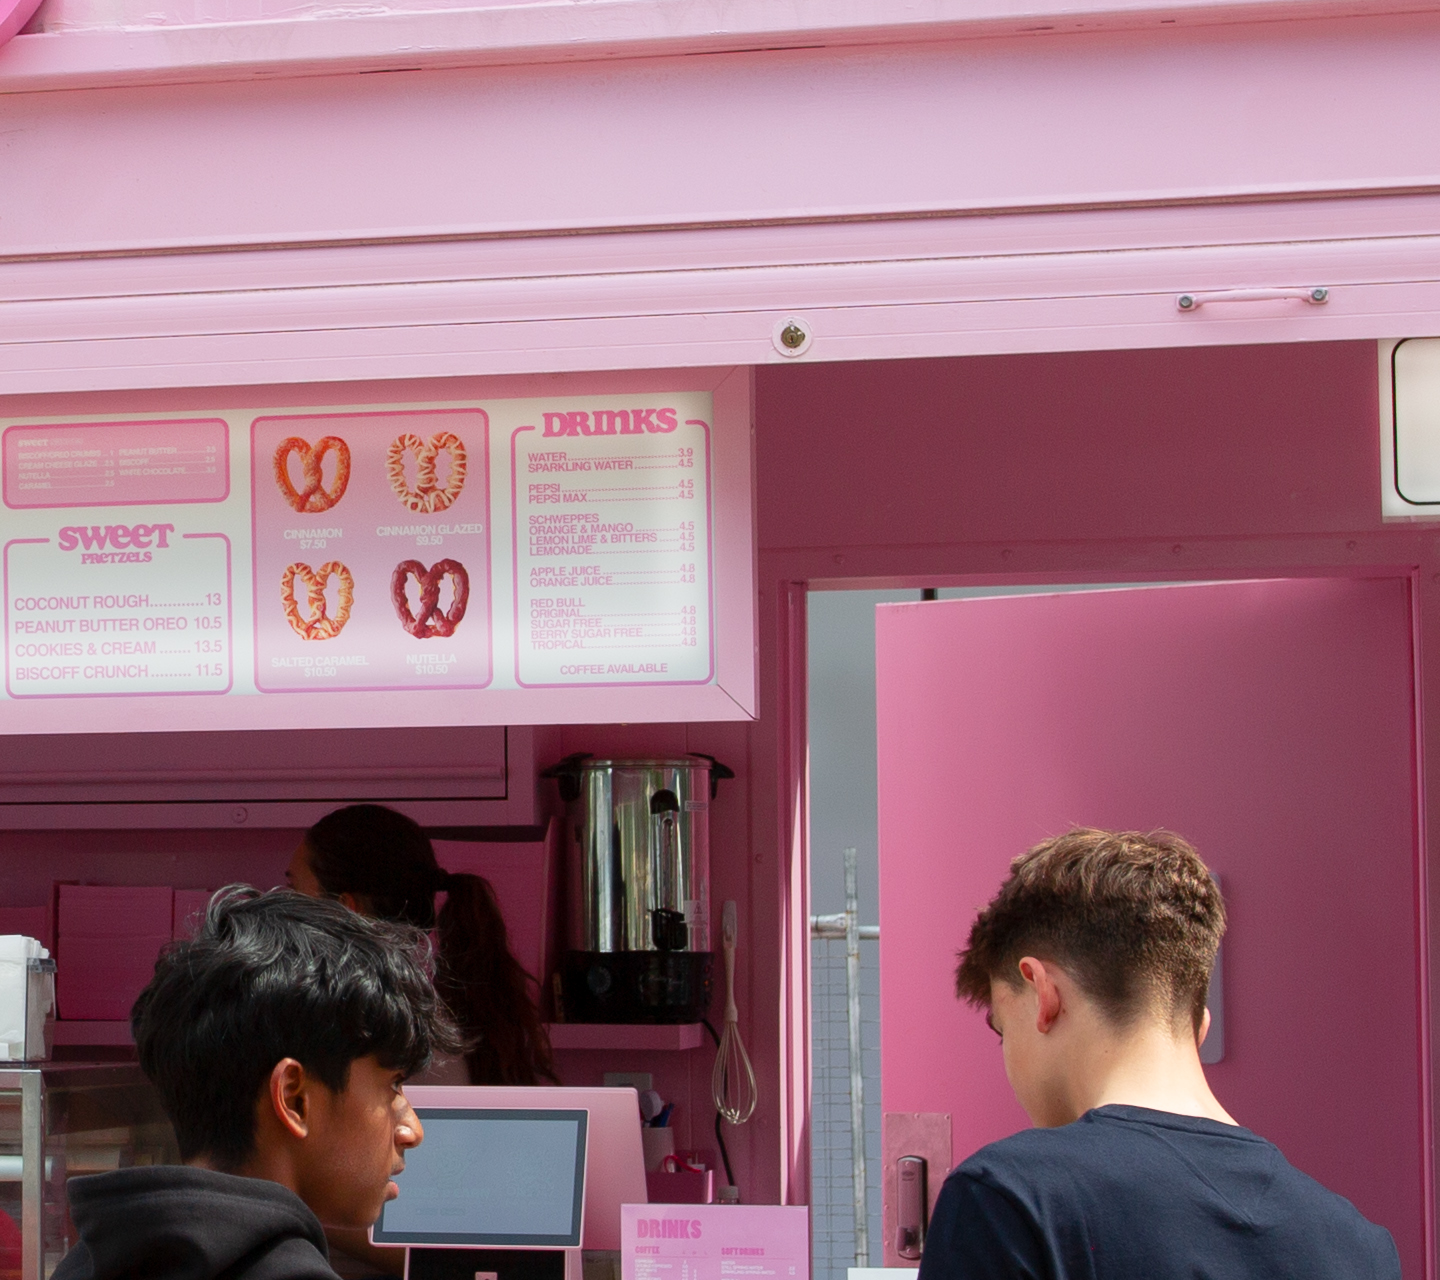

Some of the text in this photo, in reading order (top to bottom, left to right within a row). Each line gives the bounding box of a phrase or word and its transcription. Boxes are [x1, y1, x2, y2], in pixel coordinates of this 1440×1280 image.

[528, 448, 694, 463] WATER 3.9
[528, 459, 694, 473] SPARKLING WATER 4.5
[528, 479, 694, 494] PEPSI 4.5
[528, 490, 694, 505] PEPSI MAX 4.5
[529, 513, 599, 526] SCHWEPPES
[283, 528, 342, 540] CINNAMON
[376, 523, 483, 537] CINNAMON GLAZED
[529, 521, 695, 536] ORANGE & MANGO 4.5
[299, 539, 326, 551] $7.50
[416, 535, 443, 547] $9.50
[529, 532, 695, 547] LEMON LIME & BITTERS 4.5
[529, 542, 695, 557] LEMONADE 4.5
[530, 563, 696, 578] APPLE JUICE 4.8
[530, 574, 696, 588] ORANGE JUICE 4.8
[14, 593, 222, 611] COCONUT ROUGH 13
[530, 598, 585, 609] RED BULL
[530, 605, 696, 619] ORIGINAL 4.8
[15, 616, 222, 634] PEANUT BUTTER OREO 10.5
[530, 616, 696, 630] SUGAR FREE 4.8
[531, 627, 697, 640] BERRY SUGAR FREE 4.8
[15, 640, 223, 657] COOKIES & CREAM 13.5
[531, 637, 697, 651] TROPICAL 4.8
[271, 655, 369, 669] SALTED CARAMEL
[406, 654, 457, 666] NUTELLA
[15, 664, 223, 681] BISCOFF CRUNCH 11.5
[304, 666, 337, 679] $10.50
[415, 664, 449, 676] $10.50
[560, 663, 668, 676] COFFEE AVAILABLE
[636, 1218, 703, 1240] DRINKS
[634, 1245, 661, 1255] COFFEE
[721, 1247, 765, 1257] SOFT DRINKS
